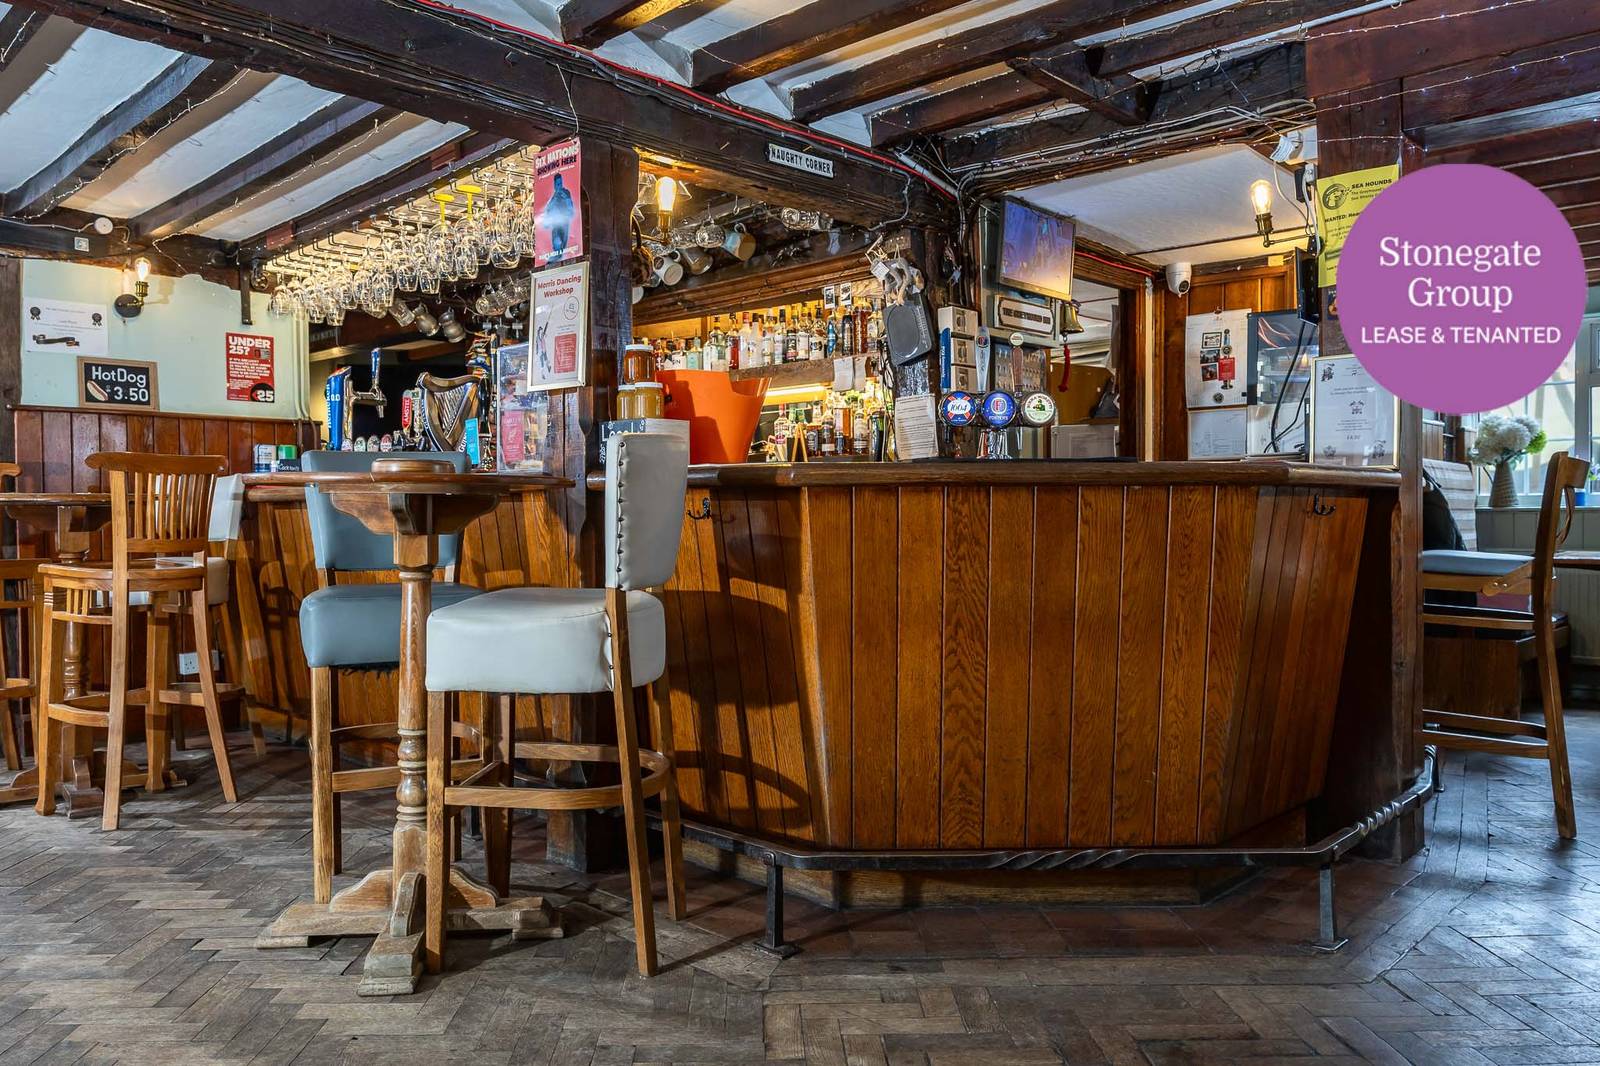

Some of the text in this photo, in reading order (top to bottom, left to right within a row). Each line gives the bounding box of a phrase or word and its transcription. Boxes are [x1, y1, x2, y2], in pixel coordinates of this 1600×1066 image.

[535, 141, 580, 169] SIX NATIONS
[771, 147, 831, 174] NAUGHTY CORNER
[536, 159, 561, 176] SHOWING
[561, 154, 577, 166] HERE
[1351, 178, 1392, 190] SEA HOUNDS
[537, 273, 582, 290] Morris Dancing
[543, 287, 574, 299] Workshop
[228, 335, 271, 349] UNDER
[229, 345, 250, 356] 25?
[92, 365, 147, 388] HotDog
